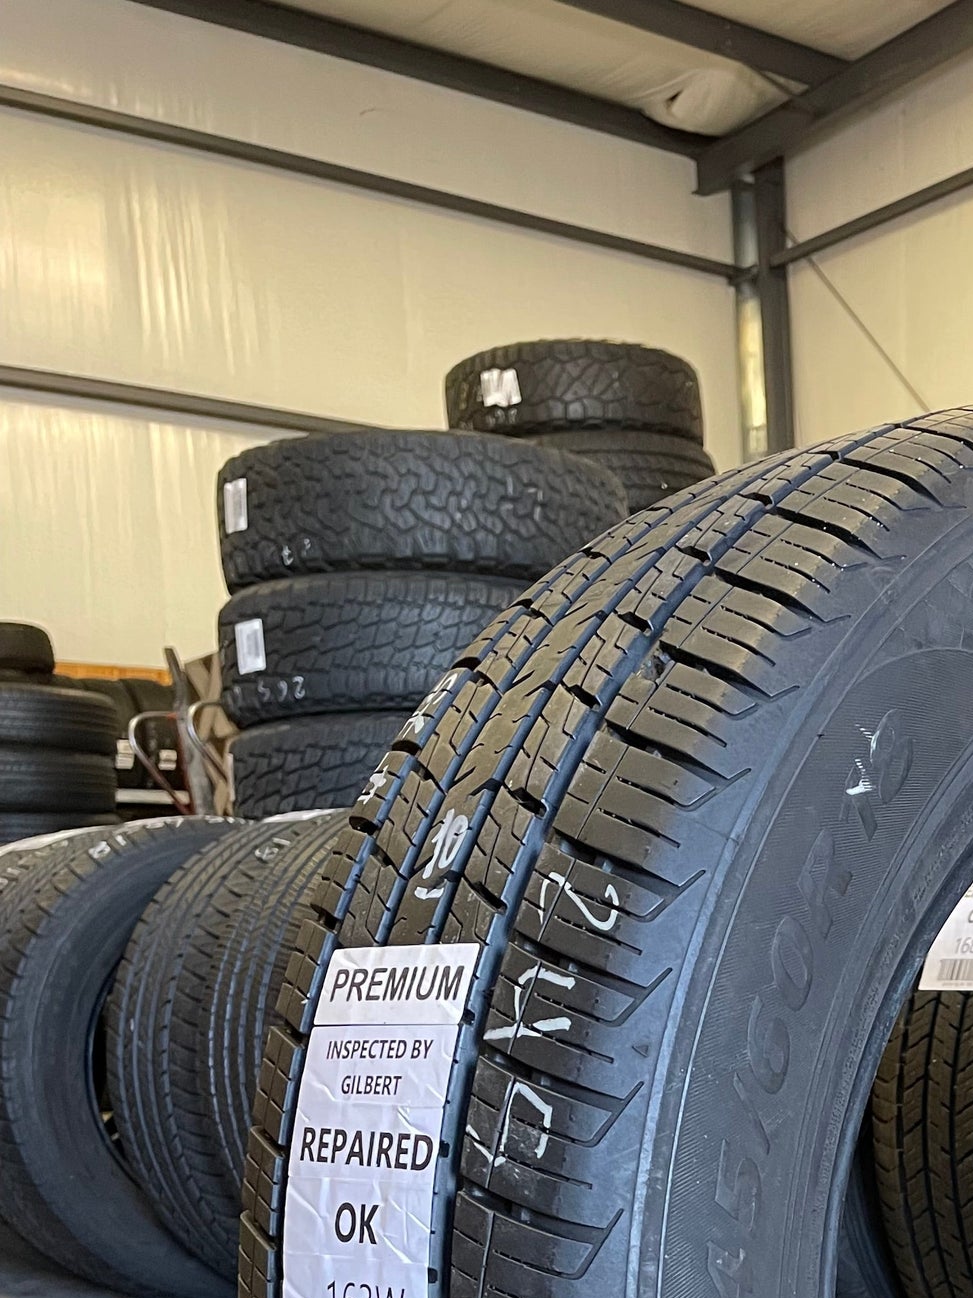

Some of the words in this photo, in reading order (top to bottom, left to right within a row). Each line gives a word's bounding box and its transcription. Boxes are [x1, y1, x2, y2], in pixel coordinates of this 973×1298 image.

[329, 965, 465, 1003] PREMIUM
[326, 1039, 407, 1060] INSPECTED
[410, 1039, 434, 1060] BY
[341, 1075, 402, 1096] GILBERT
[300, 1127, 433, 1171] REPAIRED
[334, 1202, 380, 1245] OK
